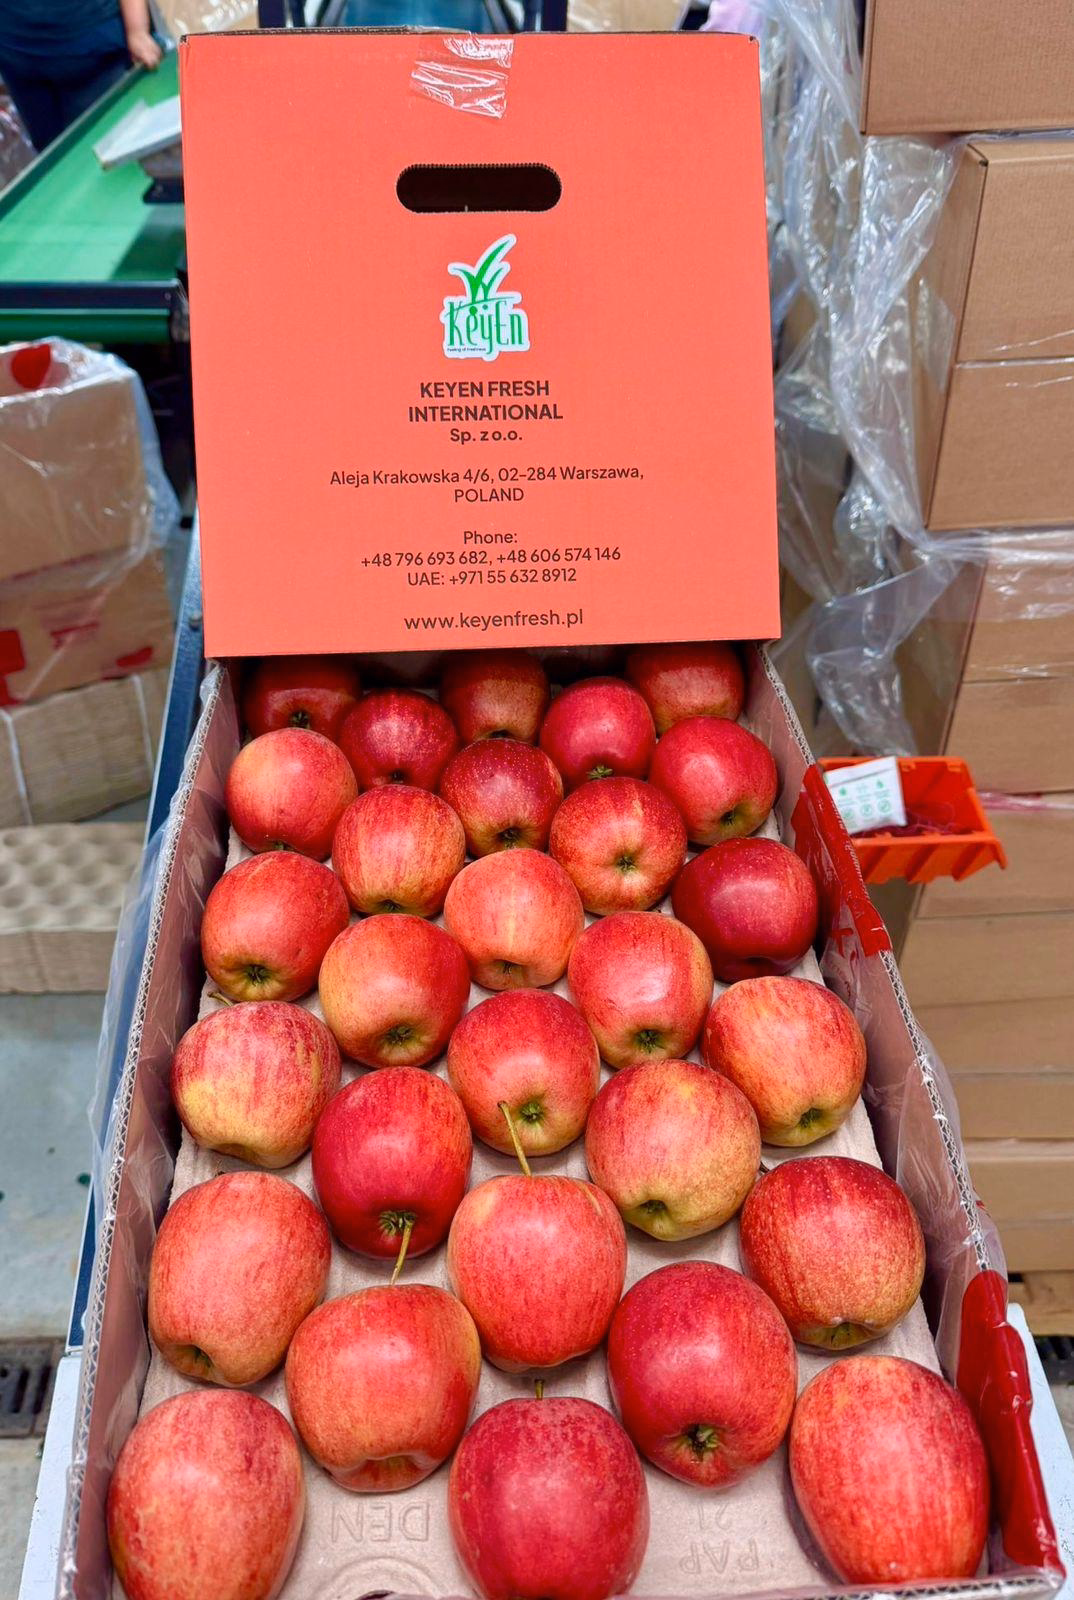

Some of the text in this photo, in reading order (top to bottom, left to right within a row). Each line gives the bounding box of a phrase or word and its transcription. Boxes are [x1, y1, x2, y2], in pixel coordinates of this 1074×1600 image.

[447, 299, 524, 354] KeyEn
[420, 380, 550, 399] KEYEN FRESH
[408, 403, 564, 423] INTERNATIONAL
[450, 427, 476, 446] Sp.
[330, 470, 370, 489] Aleja
[373, 468, 460, 485] Krakowska
[462, 468, 494, 485] 4/6,
[559, 465, 644, 481] Warszawa,
[454, 487, 525, 503] POLAND
[463, 530, 518, 545] Phone:
[361, 546, 621, 567] +48 796 693 682, +48 606 574 146
[407, 567, 577, 586] UAE: +971 55 632 8912
[403, 608, 583, 632] www.keyenfresh.pl
[679, 1537, 760, 1575] PAP
